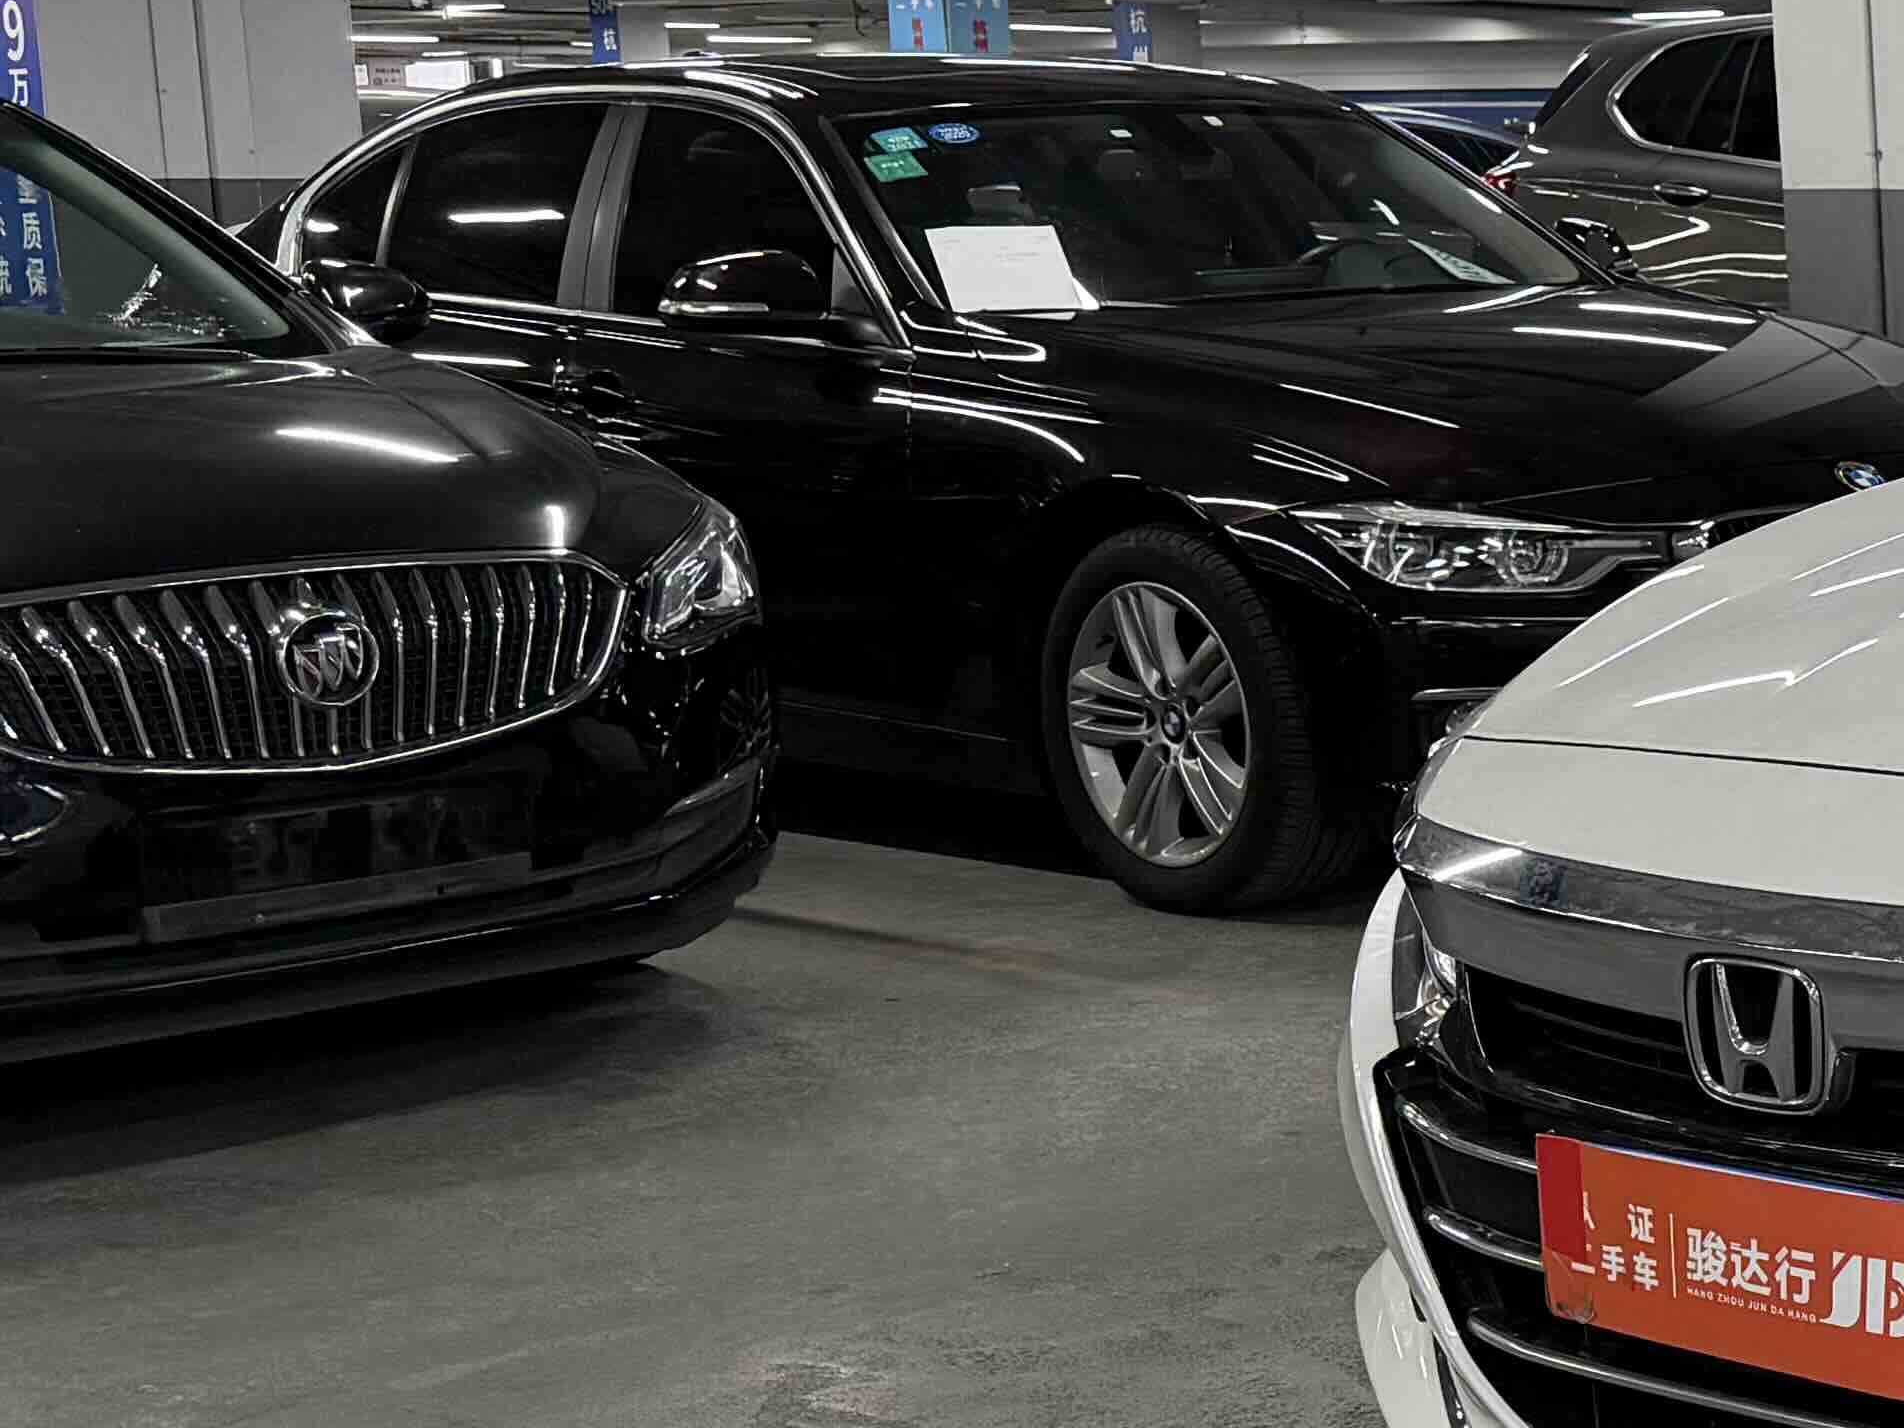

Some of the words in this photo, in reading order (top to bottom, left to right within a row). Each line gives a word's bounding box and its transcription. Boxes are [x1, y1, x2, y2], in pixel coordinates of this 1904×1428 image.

[1686, 1227, 1817, 1305] 骏达行
[1686, 1286, 1714, 1301] HANG
[1717, 1293, 1745, 1307] ZHOU
[1748, 1299, 1767, 1312] JUN
[1770, 1304, 1785, 1317] DA
